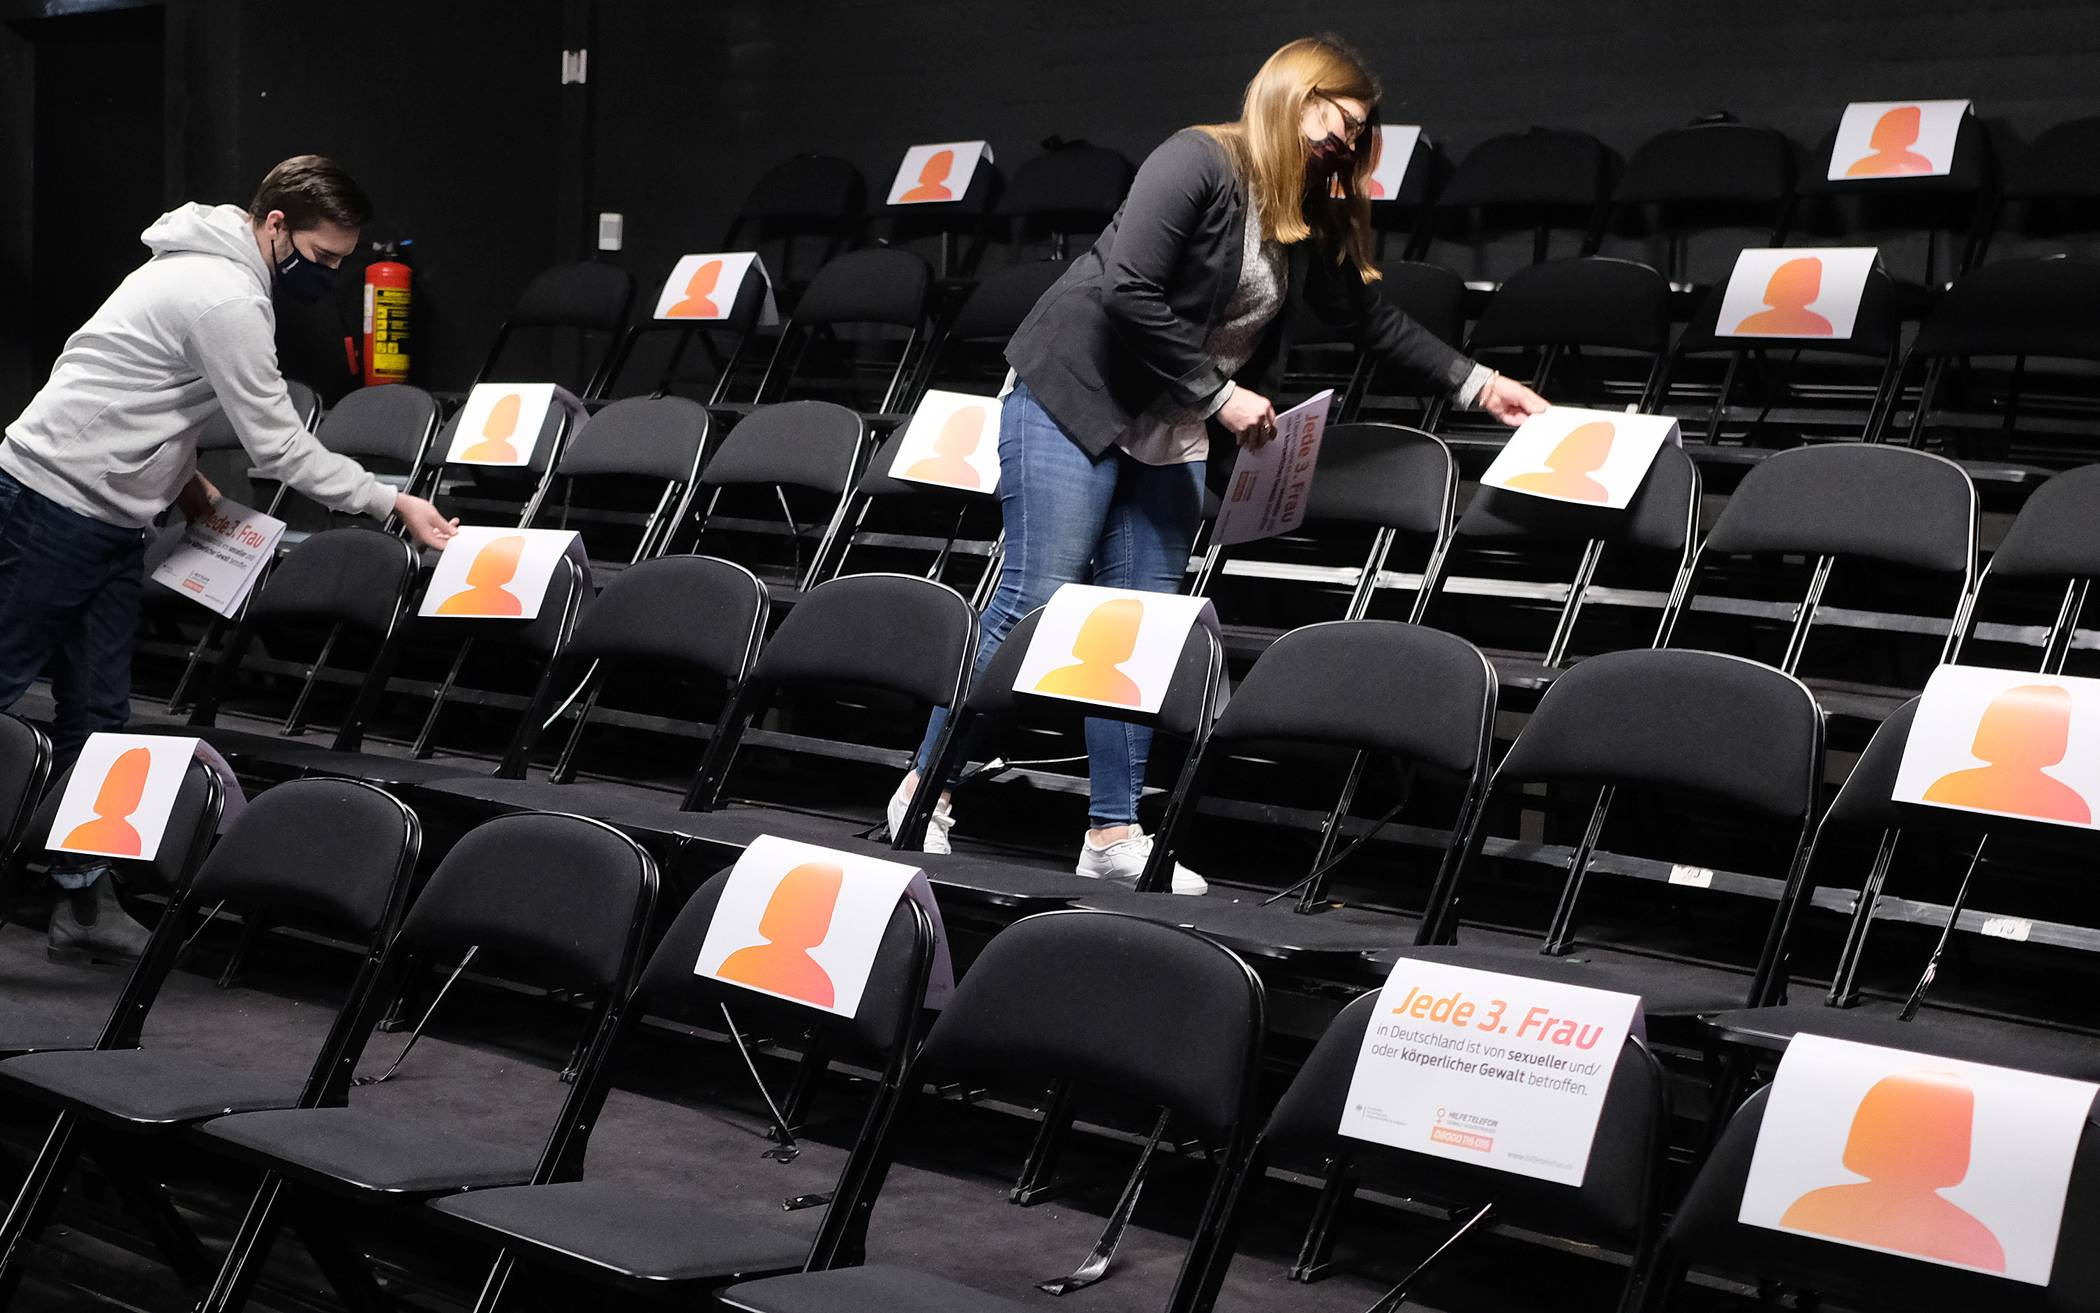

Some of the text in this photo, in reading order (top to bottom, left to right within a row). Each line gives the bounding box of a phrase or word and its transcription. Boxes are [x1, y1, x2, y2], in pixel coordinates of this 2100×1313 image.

[1297, 414, 1319, 457] Jede
[1292, 463, 1309, 481] 3.
[1281, 481, 1305, 523] Frau
[236, 523, 266, 549] Frau
[1392, 986, 1604, 1050] Jede 3. Frau
[1371, 1042, 1588, 1096] oder körperlicher Gewalt betroffen.
[1376, 1022, 1602, 1077] in Deutschland ist von sexueller und/
